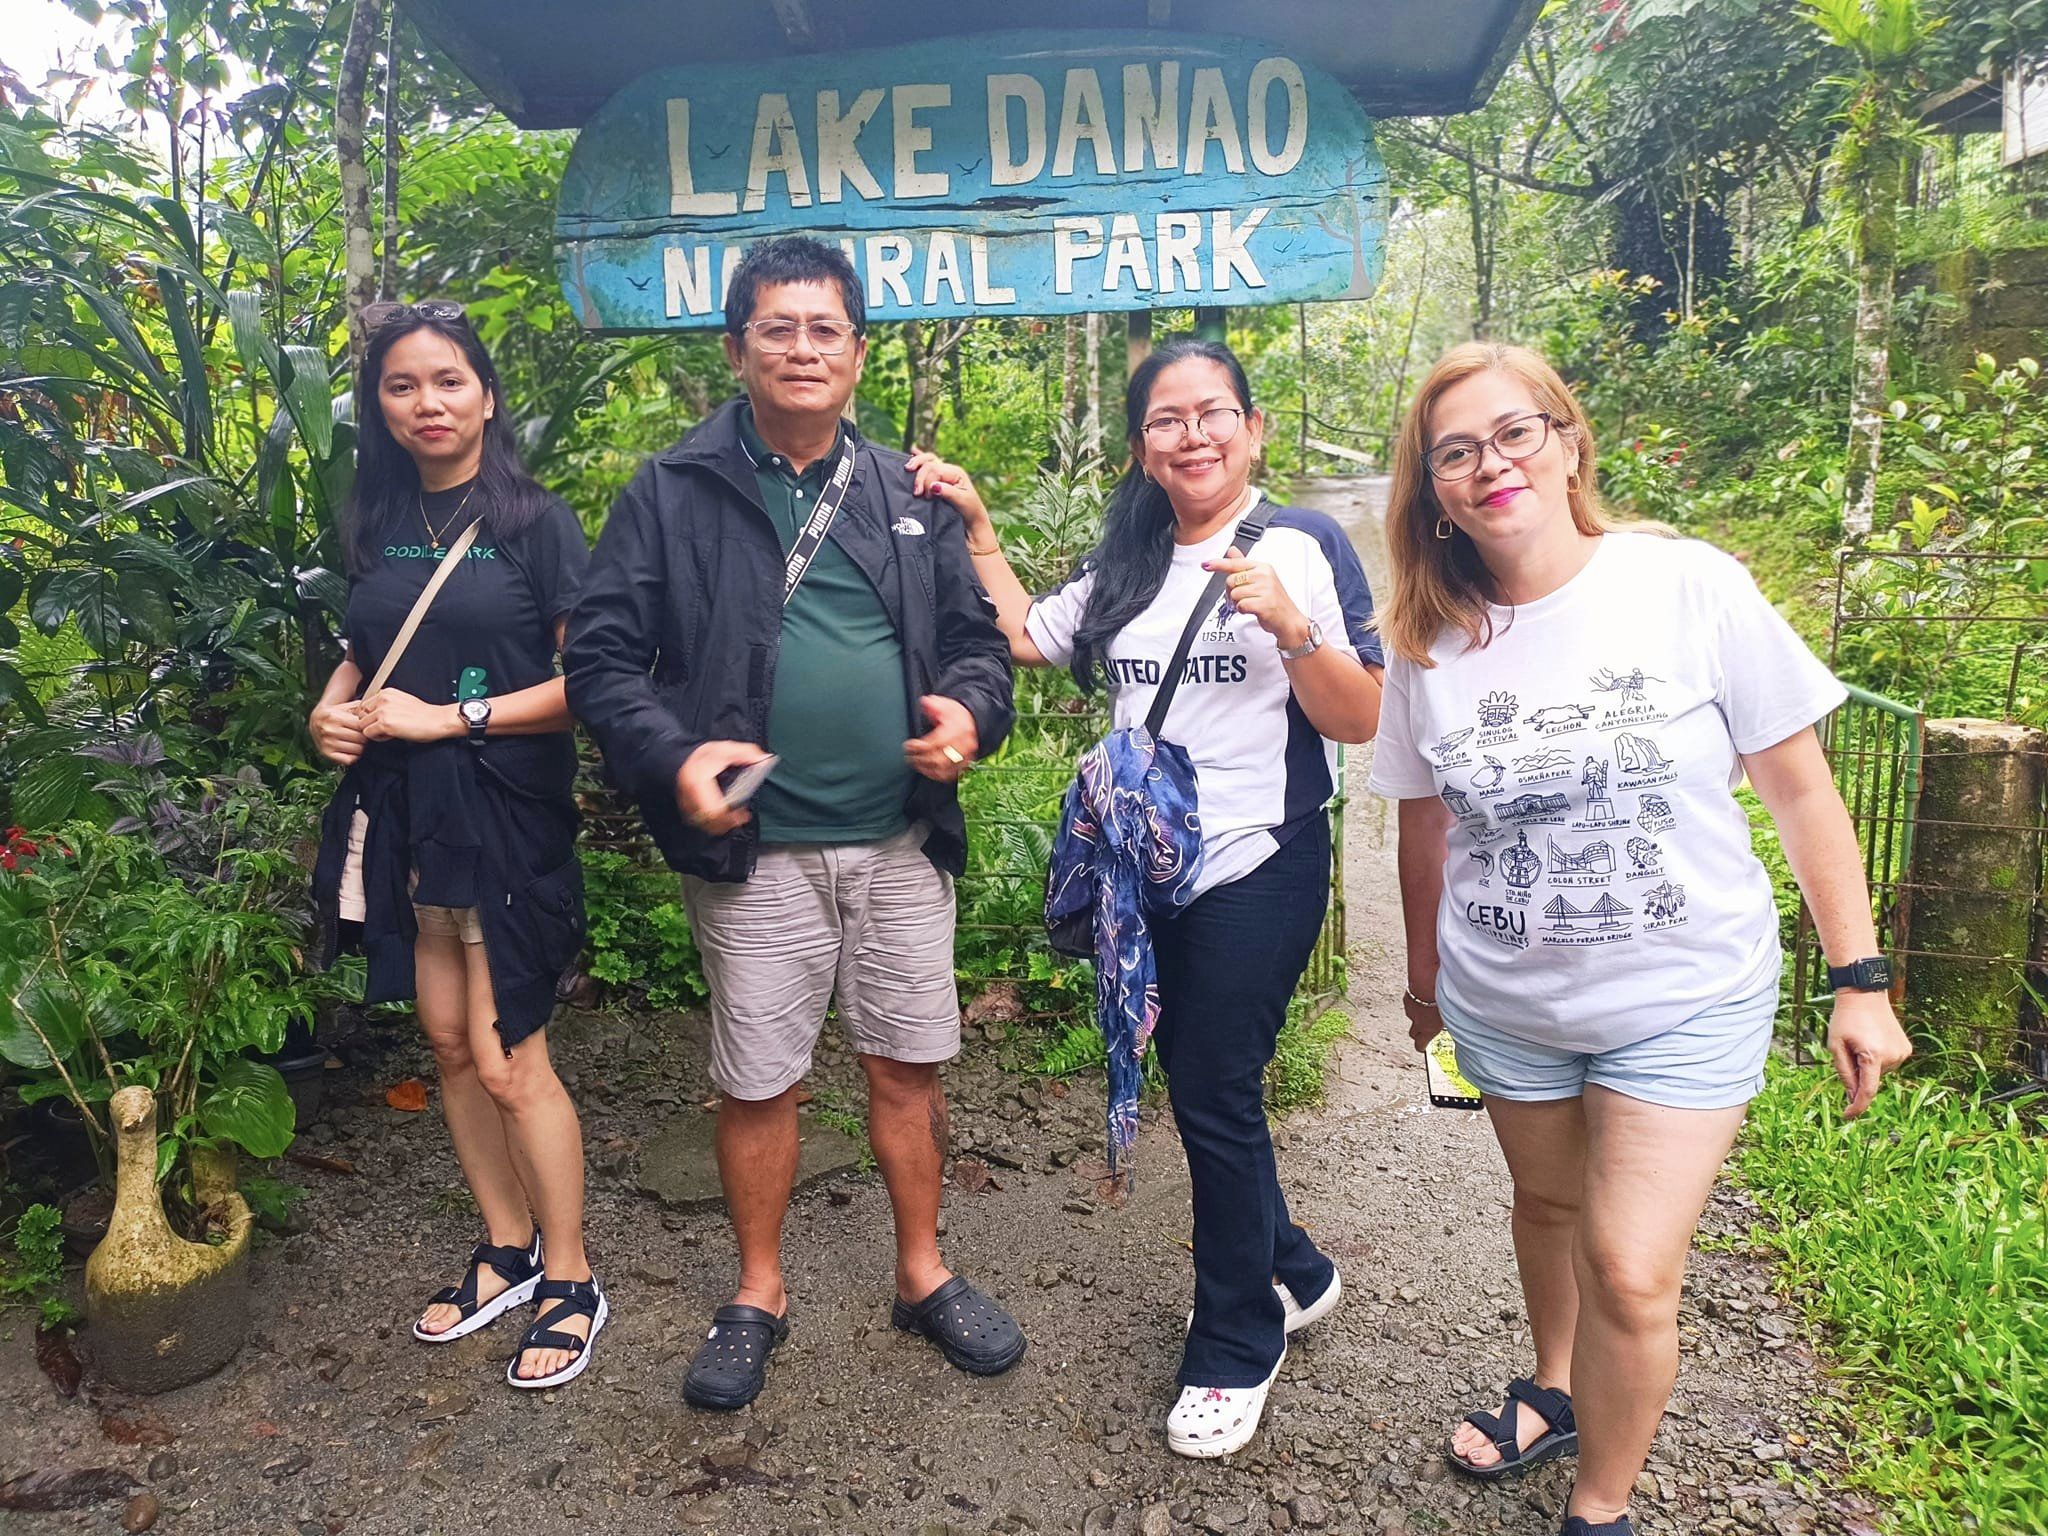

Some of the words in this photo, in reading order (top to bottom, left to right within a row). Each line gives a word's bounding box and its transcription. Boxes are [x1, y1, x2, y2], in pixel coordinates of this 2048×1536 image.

[665, 83, 952, 216] LAKE
[987, 56, 1308, 186] DANAO
[663, 232, 1017, 319] NRAL
[1053, 207, 1273, 294] PARK
[785, 553, 807, 591] UMA
[807, 502, 834, 540] PUMA
[832, 456, 851, 489] PUMA
[384, 545, 497, 559] CODILEARK
[1202, 631, 1235, 642] USPA
[1103, 658, 1160, 685] NITED
[1181, 654, 1247, 685] TATES
[1604, 704, 1656, 719] ALEGRIA
[1545, 722, 1582, 734] LECHON
[1595, 712, 1669, 730] CANYONEERING
[1477, 733, 1518, 745] FESTIVAL
[1479, 727, 1513, 738] SINULOG
[1442, 752, 1467, 762] OSLOB
[1617, 777, 1657, 789] KAWASAN
[1658, 772, 1678, 783] FALLS
[1479, 787, 1505, 797] MANGO
[1653, 817, 1675, 828] PUSO
[1547, 876, 1574, 884] COLON
[1577, 875, 1611, 884] STREET
[1626, 867, 1665, 879] DANGGIT
[1467, 901, 1526, 936] CEBU
[1643, 920, 1666, 930] SIRAO
[1668, 916, 1688, 925] PEAK
